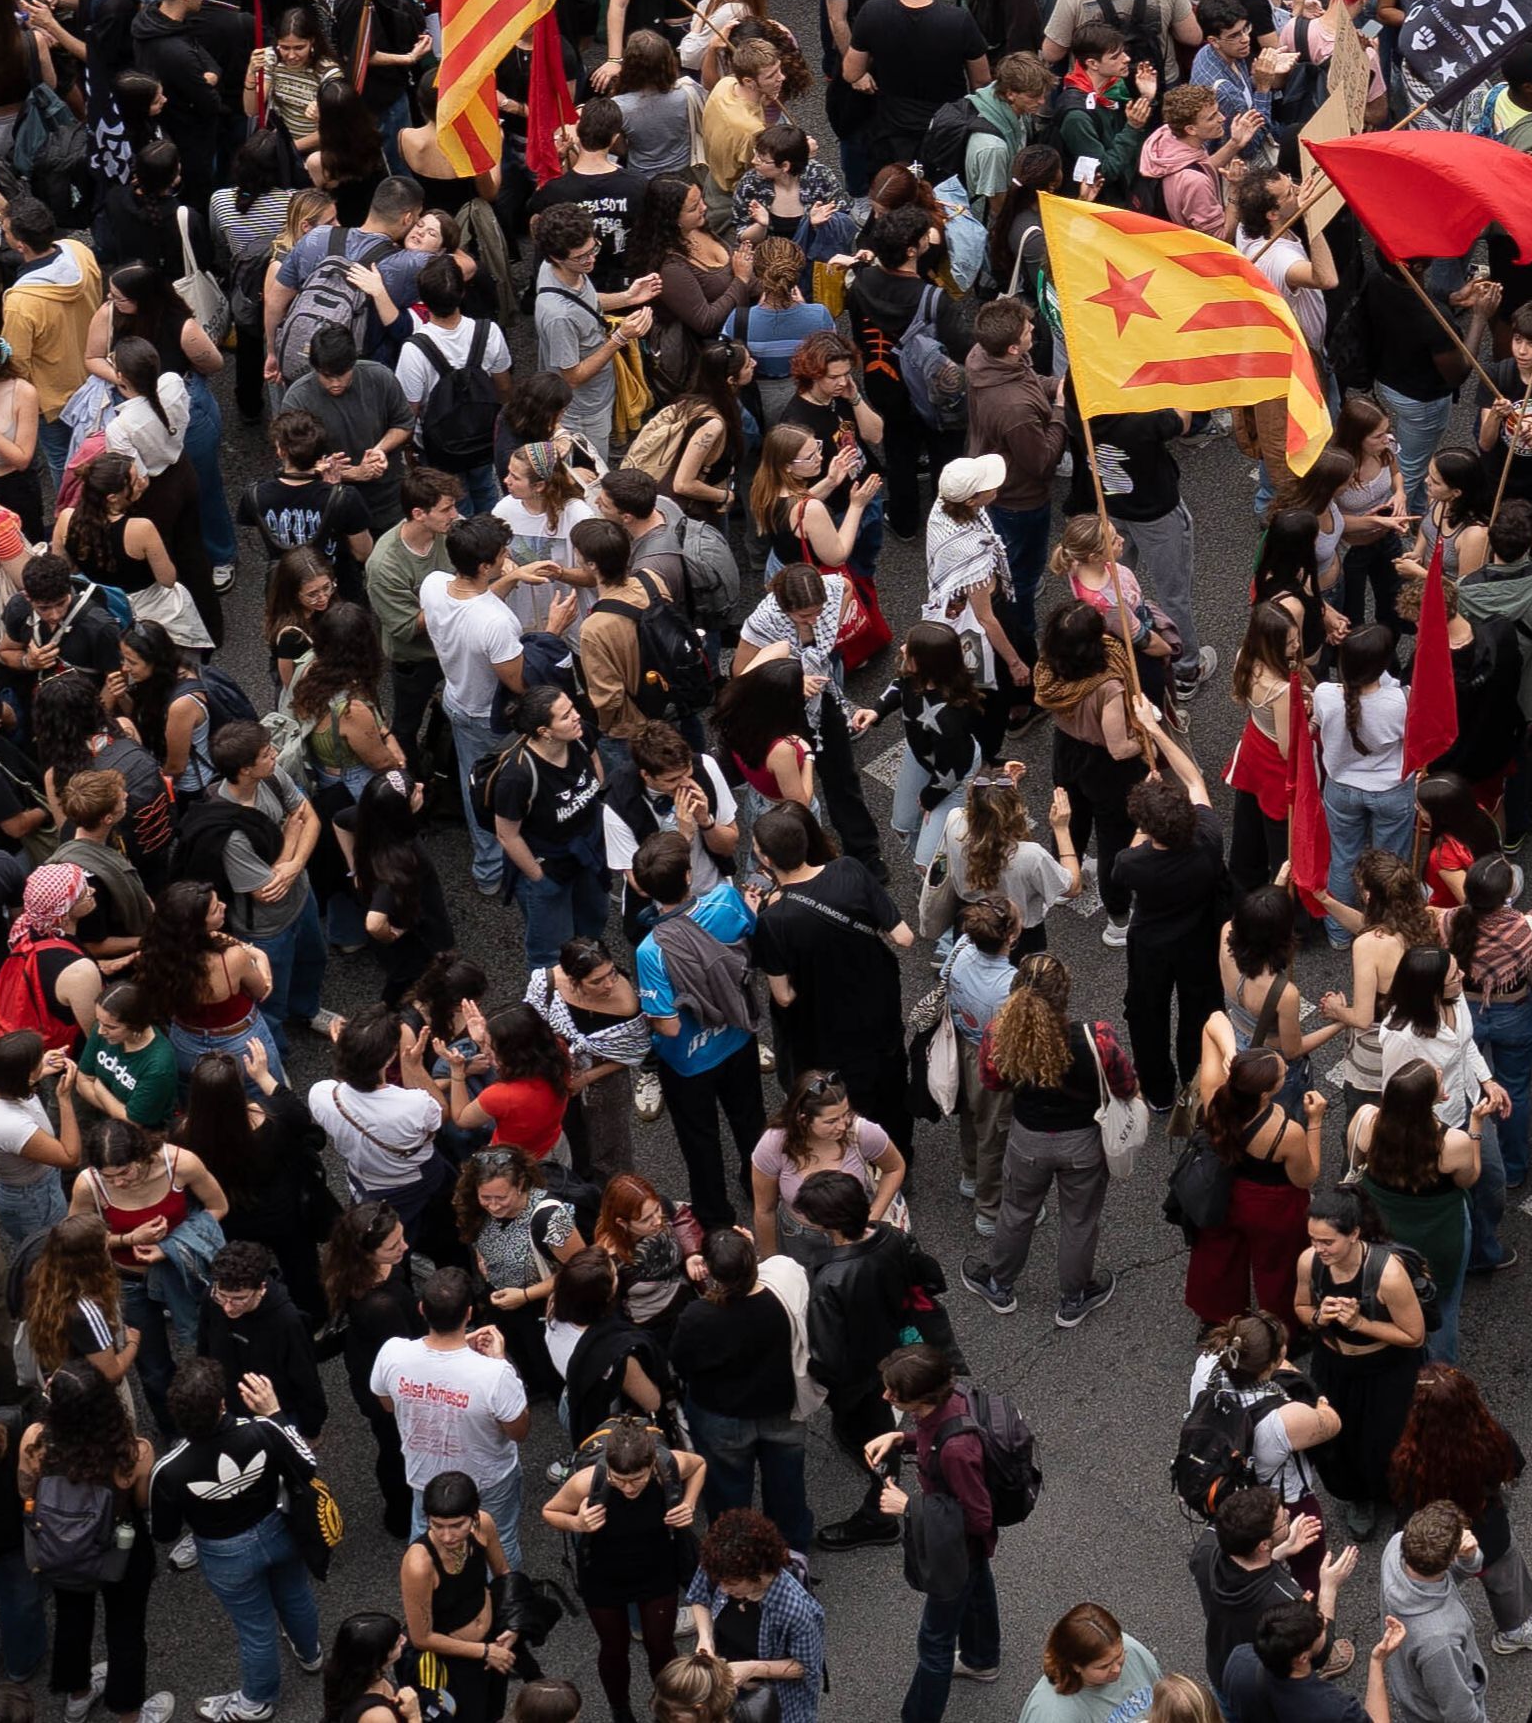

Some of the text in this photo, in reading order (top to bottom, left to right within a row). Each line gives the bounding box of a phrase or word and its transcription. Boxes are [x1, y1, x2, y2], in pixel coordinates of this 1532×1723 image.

[787, 891, 816, 909] UNDER
[815, 904, 850, 924] ARMOUR
[97, 1049, 136, 1091] adidas
[398, 1377, 470, 1409] Salsa Romesco
